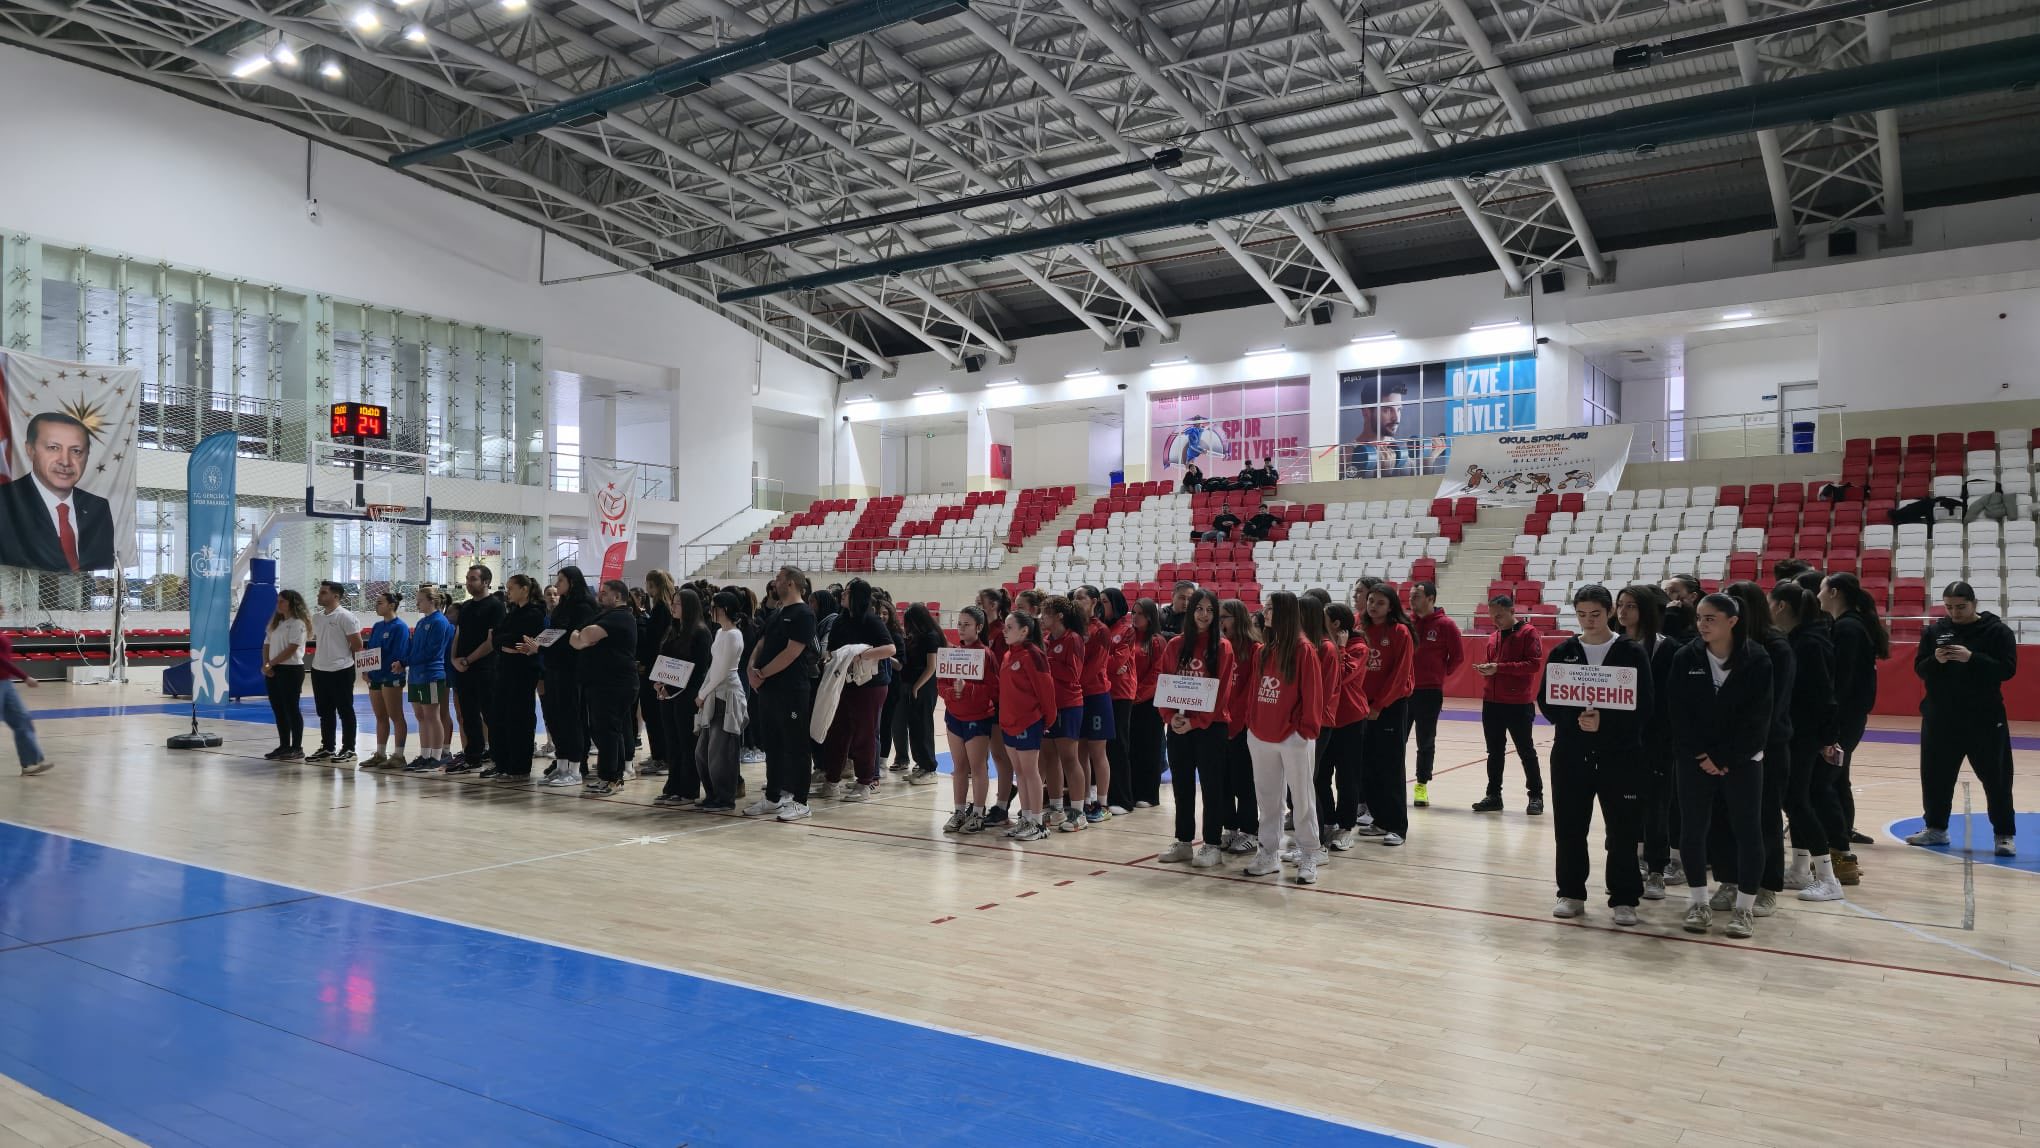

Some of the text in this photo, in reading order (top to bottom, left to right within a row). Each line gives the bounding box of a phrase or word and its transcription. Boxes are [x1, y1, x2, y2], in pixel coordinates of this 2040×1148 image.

[333, 415, 346, 433] 24
[358, 416, 379, 434] 24
[1222, 418, 1261, 439] SPOR
[1499, 432, 1588, 444] OKUL SPORLARI
[601, 521, 626, 537] TVF
[356, 655, 379, 668] BURSA
[939, 661, 979, 676] BİLECİK
[1550, 683, 1634, 705] ESKİŞEHİR
[1092, 715, 1102, 730] 8
